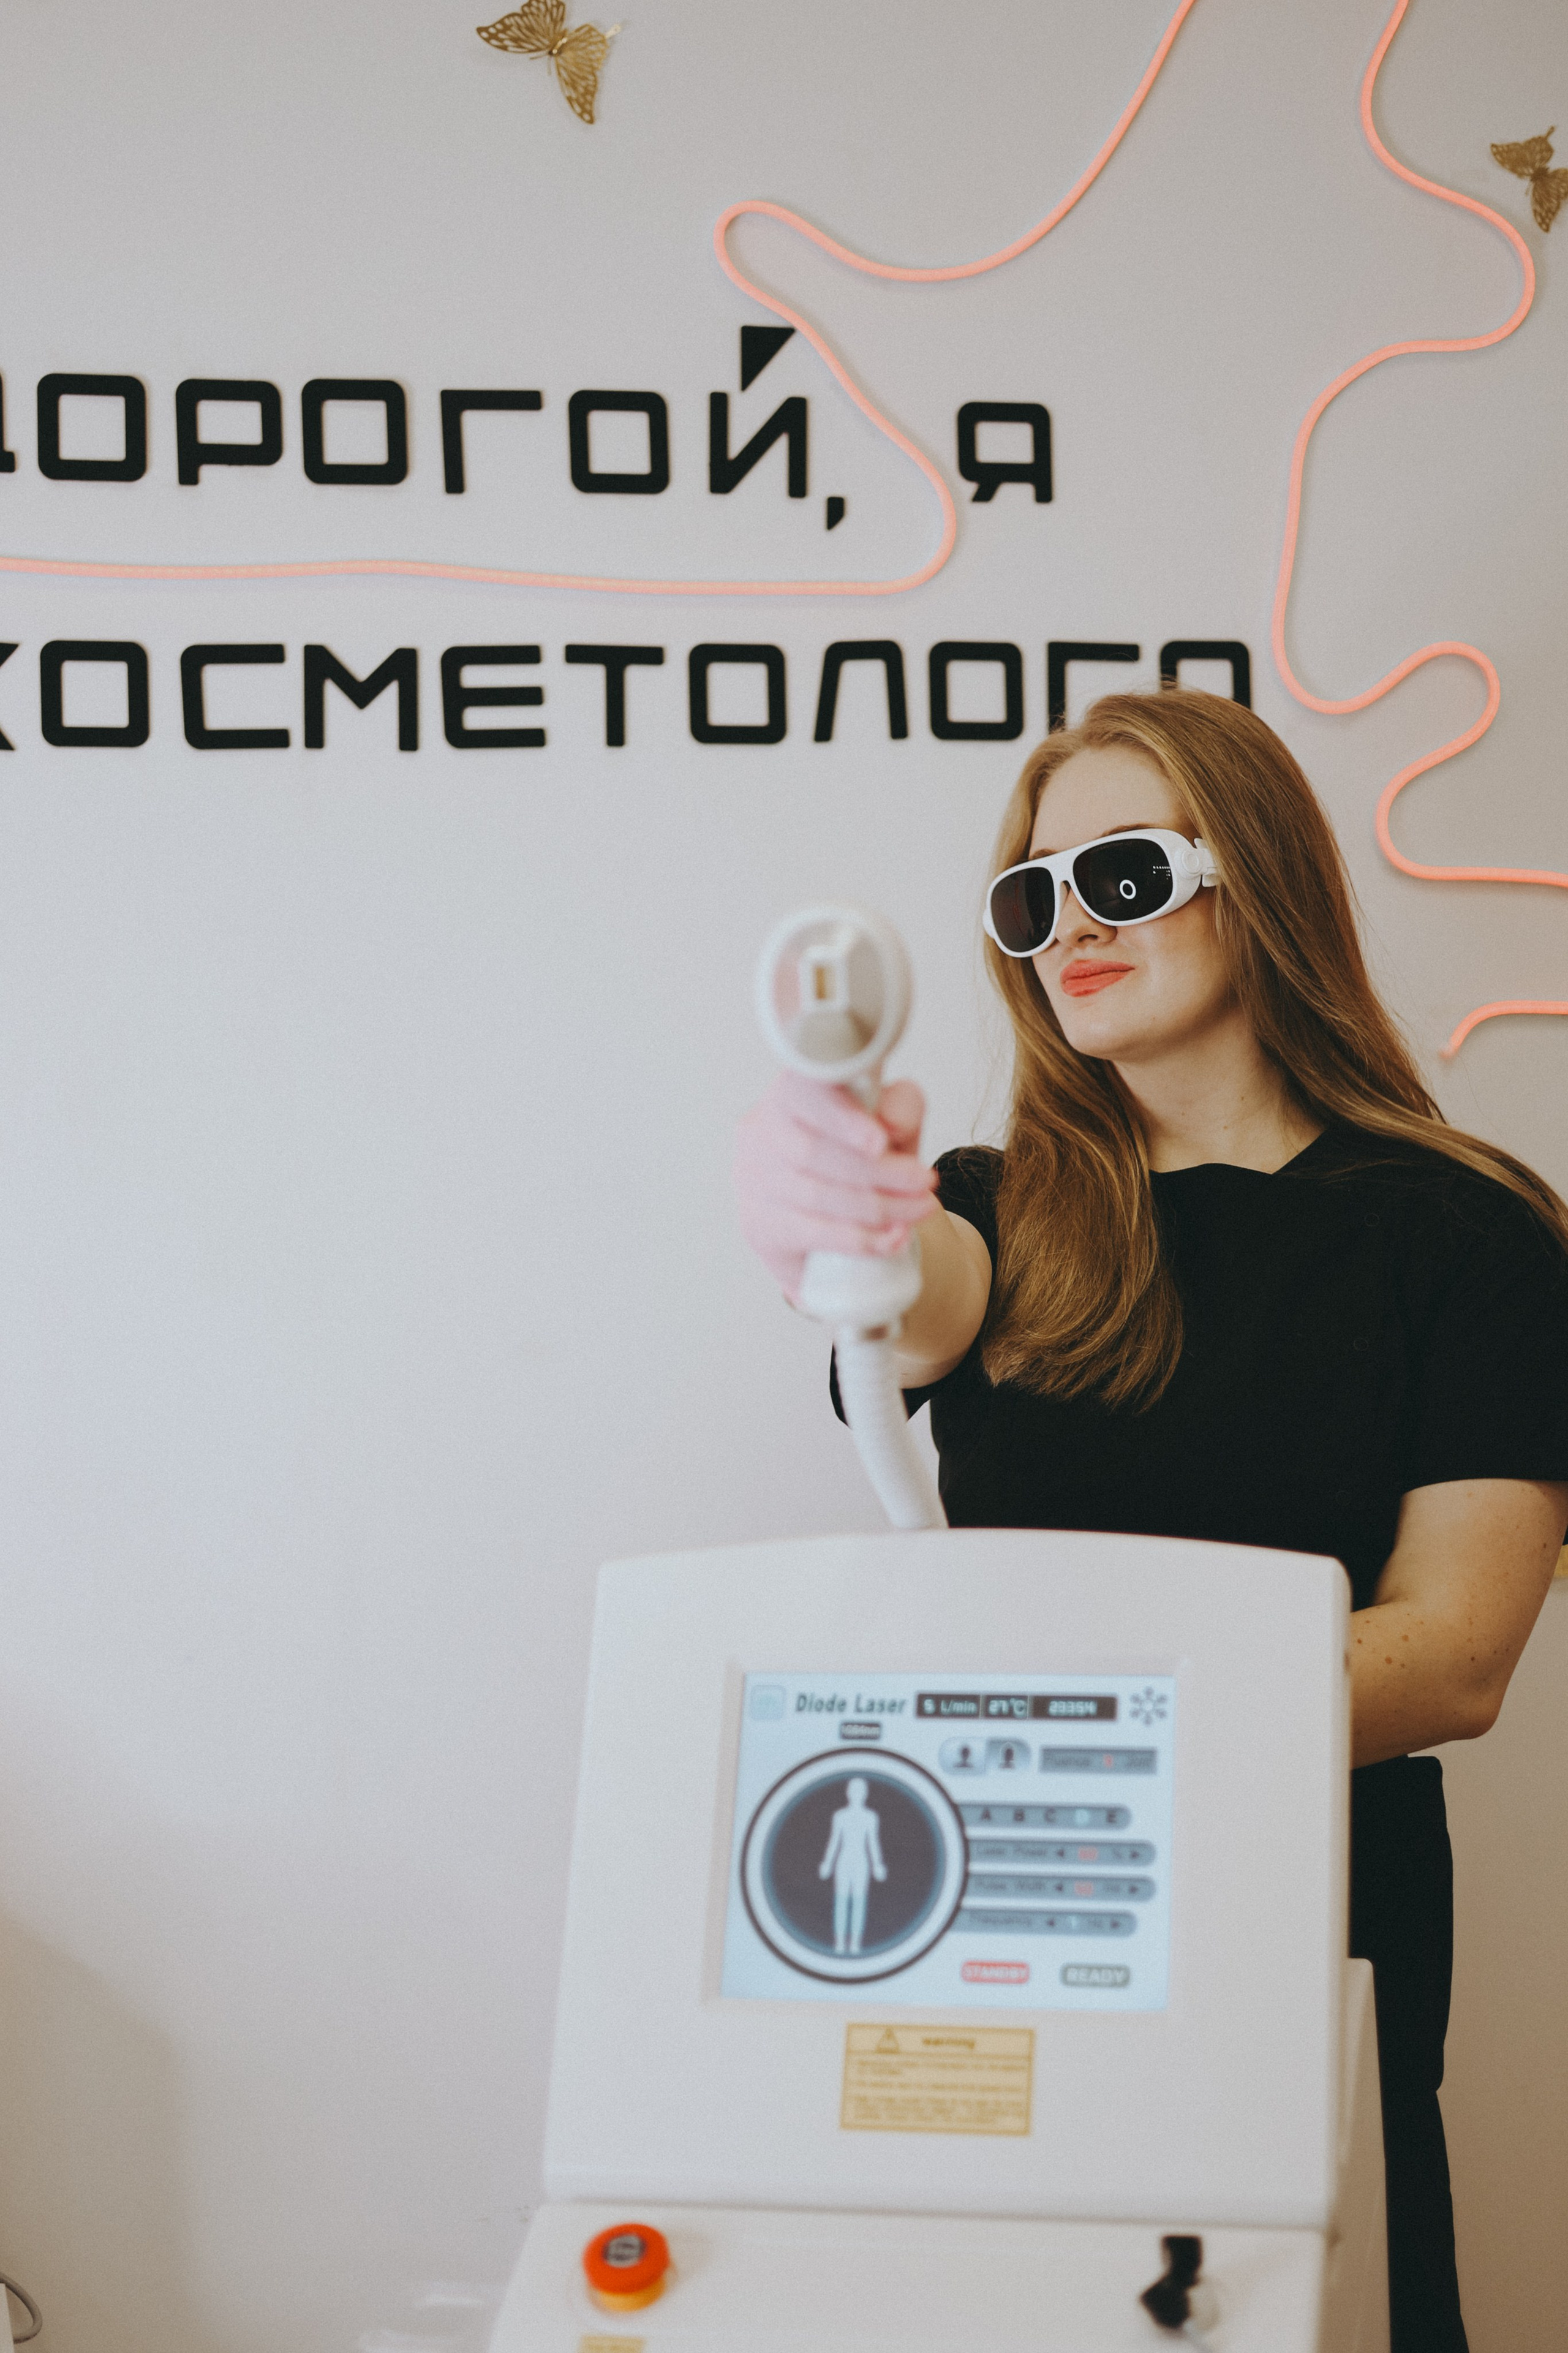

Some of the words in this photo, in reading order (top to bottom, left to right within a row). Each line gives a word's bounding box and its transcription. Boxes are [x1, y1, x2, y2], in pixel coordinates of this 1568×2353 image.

[0, 326, 845, 531] ОРОГОЙ,
[957, 401, 1053, 504] Я
[797, 1692, 846, 1712] Diode
[855, 1693, 906, 1713] Laser
[981, 1808, 992, 1821] A
[1067, 1967, 1127, 1982] READY
